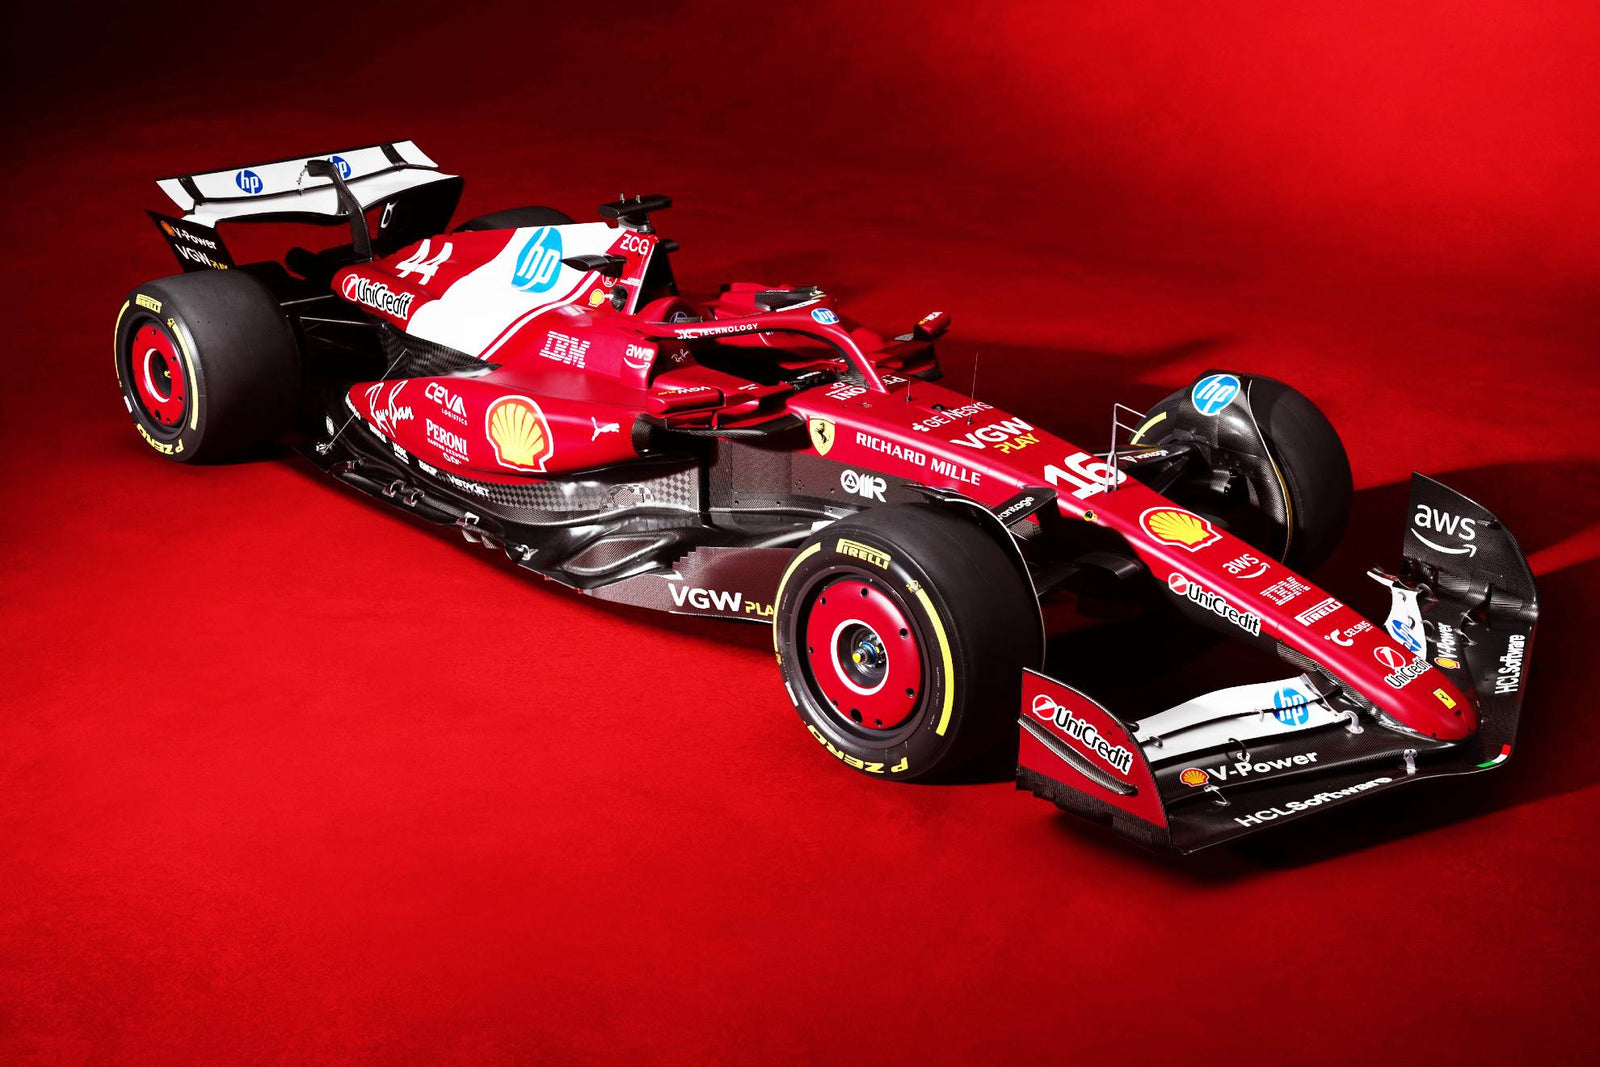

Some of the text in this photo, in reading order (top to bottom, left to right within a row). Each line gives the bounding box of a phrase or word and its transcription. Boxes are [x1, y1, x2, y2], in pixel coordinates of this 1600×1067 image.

[238, 170, 261, 194] hp
[174, 243, 212, 267] VGW
[515, 227, 560, 292] hp
[620, 233, 650, 255] ZCG
[395, 238, 453, 285] 44
[357, 277, 415, 321] UniCredit
[699, 323, 759, 337] TECHNOLOGY
[813, 308, 838, 324] hp
[539, 330, 590, 369] IBM
[625, 344, 654, 361] aws
[1194, 375, 1240, 415] hp
[922, 401, 994, 428] GENESYS
[136, 423, 174, 455] ZERO
[425, 418, 468, 455] PERONI
[949, 416, 1034, 449] VGW
[993, 433, 1040, 454] PLAY
[856, 431, 982, 486] RICHARD MILLE
[1044, 452, 1127, 499] 16
[1414, 504, 1476, 540] aws
[835, 538, 892, 570] PIRELLI
[1222, 553, 1259, 574] aws
[668, 583, 742, 612] VGW
[744, 601, 774, 617] PLA
[1259, 576, 1311, 606] IBM
[1187, 583, 1262, 637] UniCredit
[1294, 597, 1344, 627] PIRELLI
[1343, 620, 1371, 638] CELSIUS
[1438, 622, 1453, 659] V-Power
[1384, 657, 1433, 689] UniCredit
[1494, 634, 1525, 695] HCLSoftware
[1275, 687, 1307, 726] hp
[807, 724, 909, 773] P ZERO
[1053, 704, 1133, 775] UniCredit
[1208, 750, 1319, 782] V-Power
[1233, 776, 1393, 828] HCLSoftware
